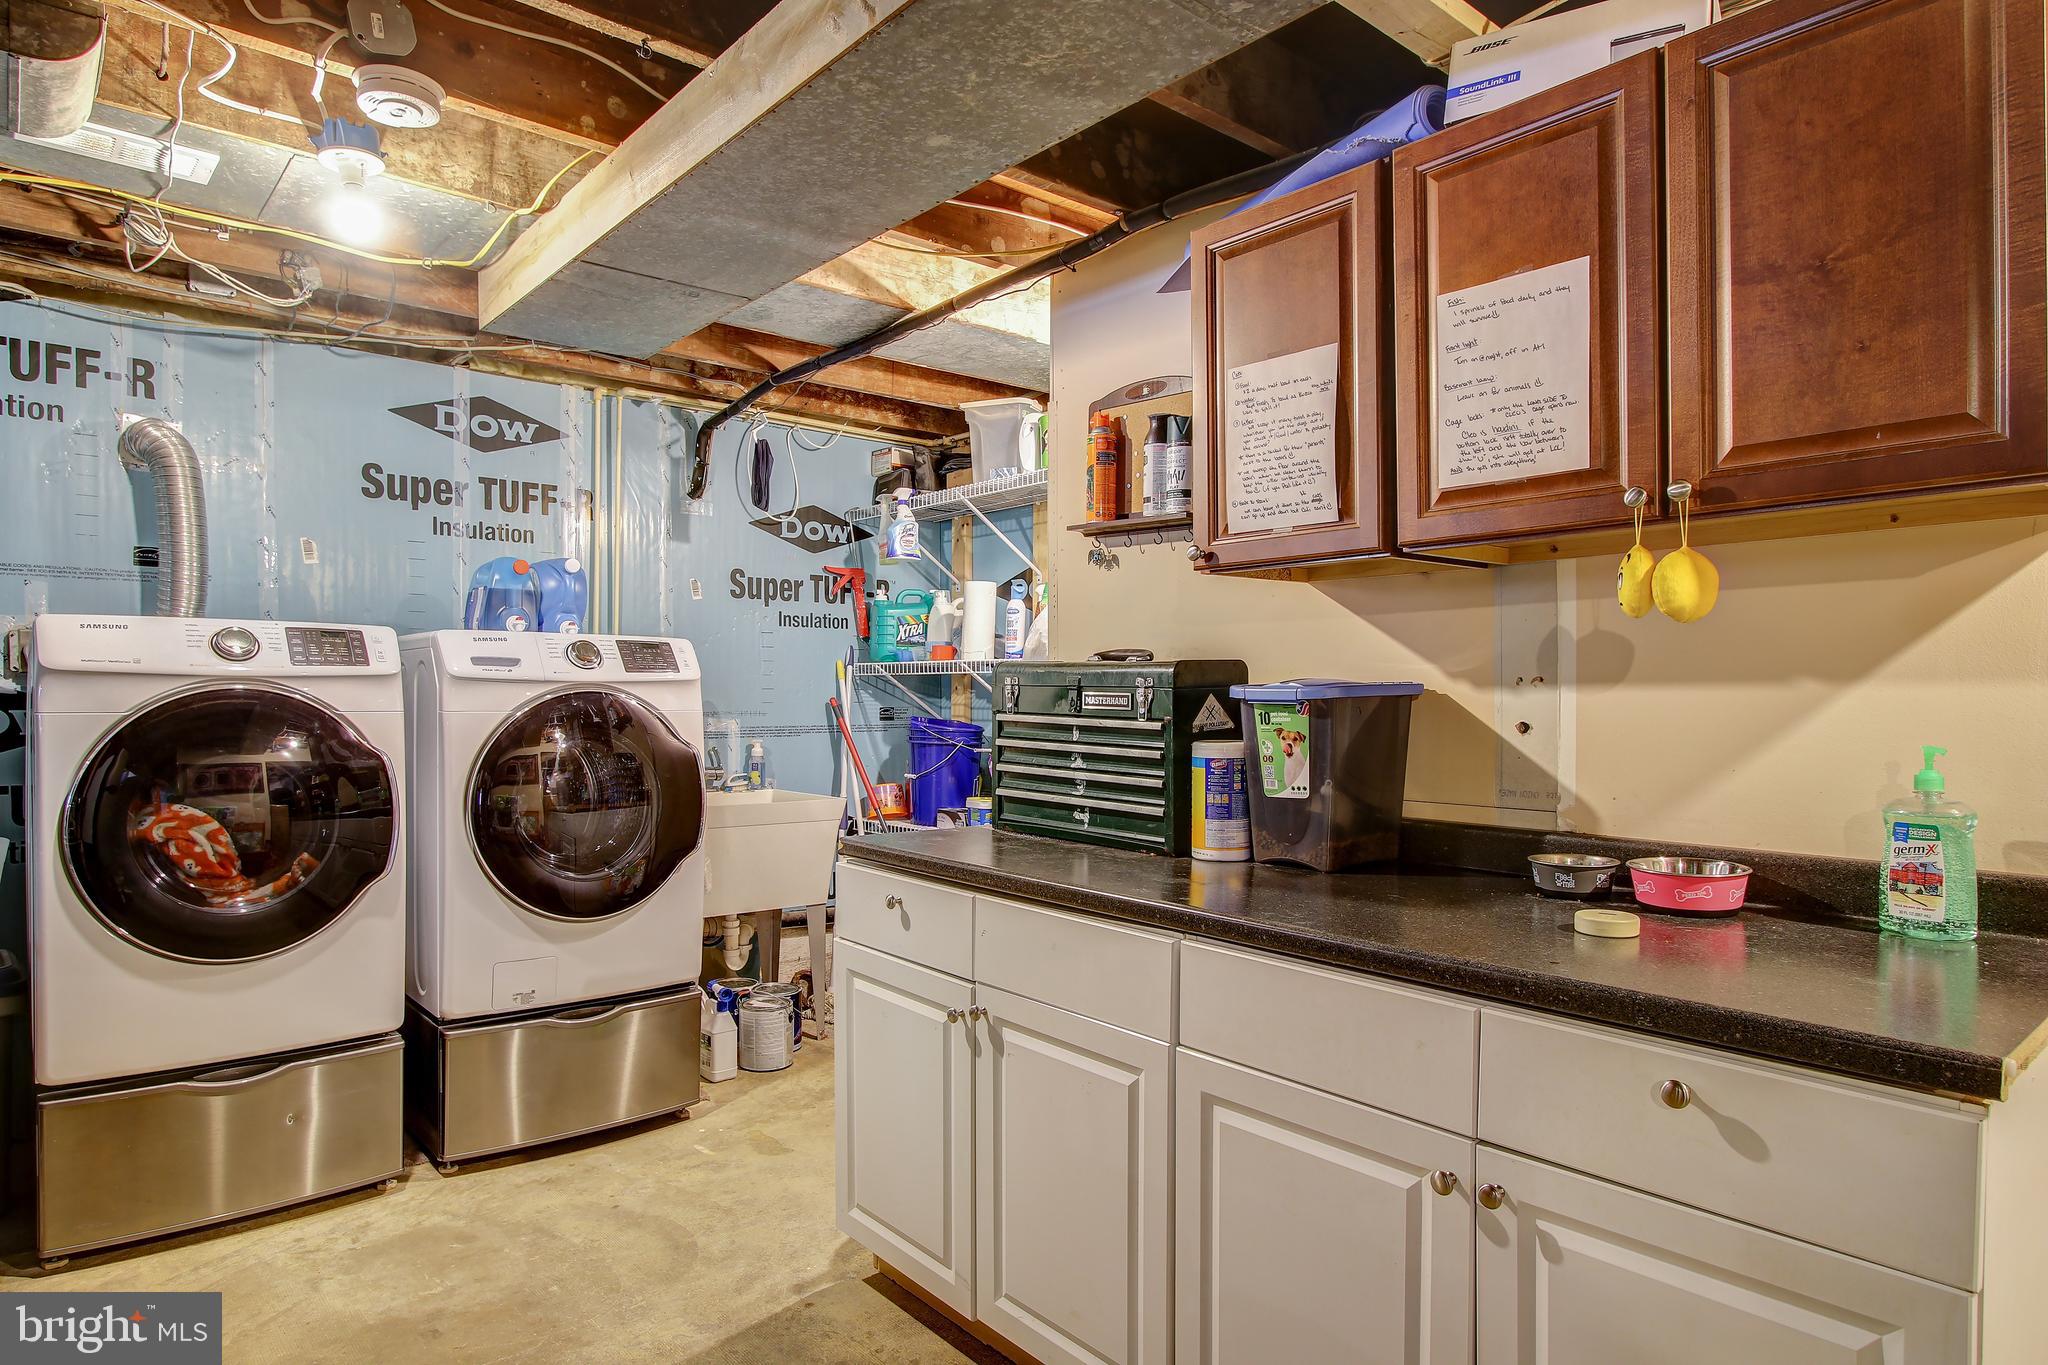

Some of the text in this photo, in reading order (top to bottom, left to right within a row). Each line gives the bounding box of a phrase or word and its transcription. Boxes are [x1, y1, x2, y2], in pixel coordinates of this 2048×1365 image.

[1463, 36, 1518, 56] BOSE
[1459, 74, 1517, 94] SoundLink III
[1538, 288, 1552, 296] and
[1556, 284, 1571, 293] they
[1452, 320, 1466, 328] will
[1505, 348, 1518, 357] off
[0, 335, 156, 400] UFF-R
[1504, 382, 1532, 392] animals
[0, 394, 64, 422] tion
[1456, 440, 1480, 449] bottom
[1519, 429, 1538, 439] totally
[1489, 444, 1502, 452] and
[1534, 434, 1564, 446] between
[361, 462, 470, 510] Super
[432, 516, 535, 544] Insulation
[729, 568, 804, 608] Super
[778, 610, 848, 630] Insulation
[896, 622, 923, 640] XTRA
[1085, 696, 1128, 705] MASTERHAND
[1259, 712, 1270, 725] 10
[1909, 830, 1937, 838] DESIGN
